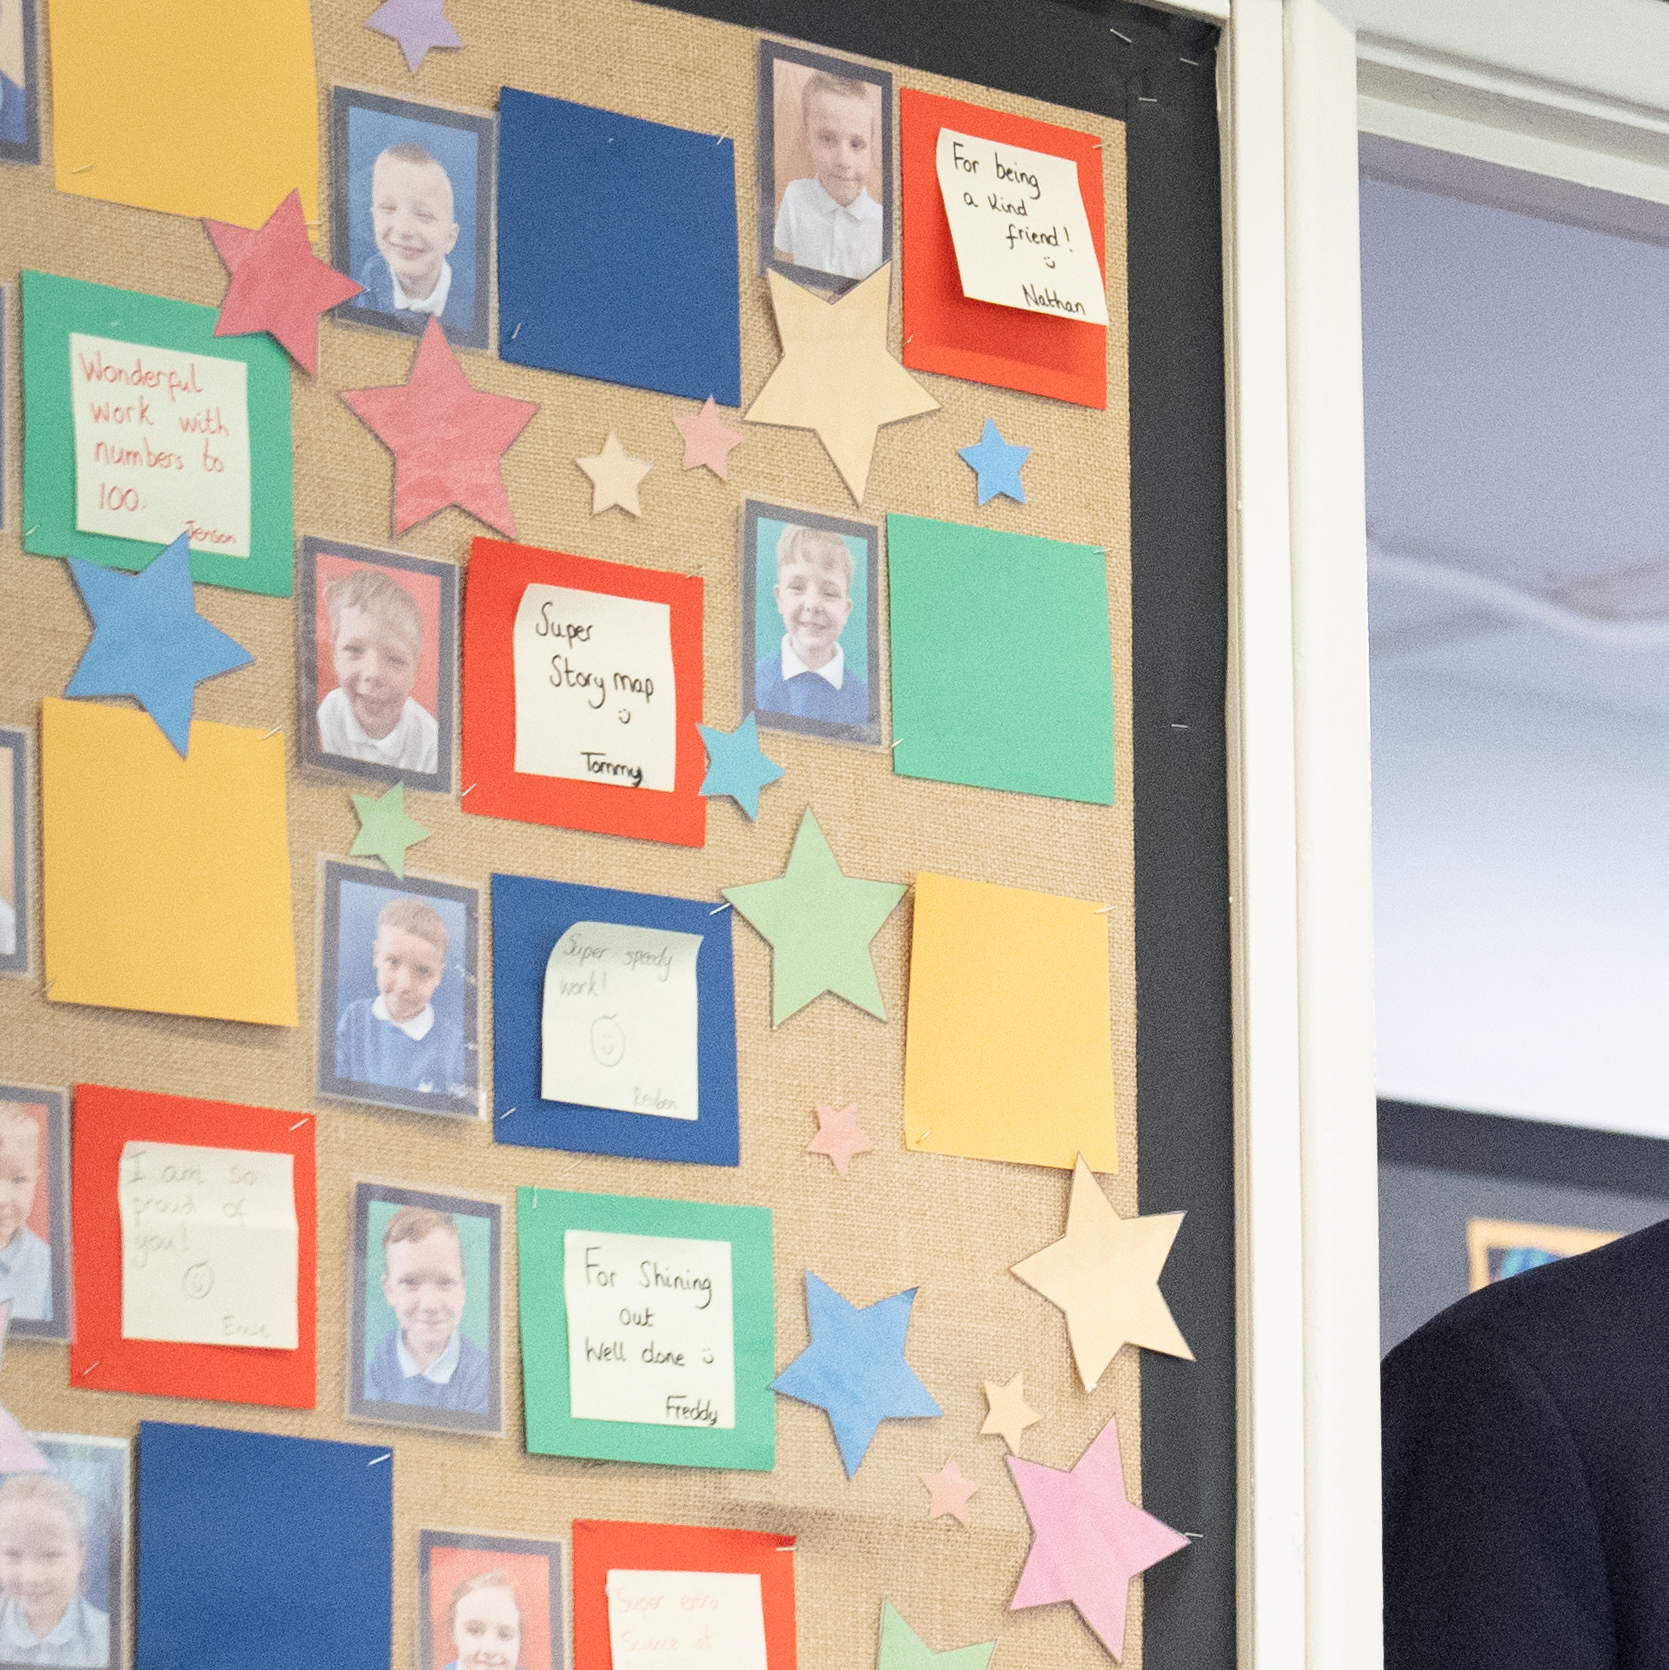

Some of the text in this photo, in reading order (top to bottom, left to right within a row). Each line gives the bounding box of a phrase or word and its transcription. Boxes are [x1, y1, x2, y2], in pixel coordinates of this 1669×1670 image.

[953, 141, 1041, 200] For being
[963, 192, 978, 207] a
[1021, 283, 1086, 316] Nathan
[80, 350, 204, 402] Wonderful
[179, 407, 230, 436] with
[94, 436, 225, 472] numbers to
[185, 519, 237, 544] Jenson
[535, 601, 594, 648] Super
[550, 654, 654, 709] Story map
[580, 751, 644, 788] Tommy
[563, 932, 673, 982] Super speedy
[124, 1152, 146, 1183] I
[162, 1165, 205, 1184] am
[134, 1192, 246, 1228] proud of
[585, 1247, 617, 1288] For
[585, 1336, 686, 1367] Well done
[665, 1394, 719, 1426] Freddy
[614, 1585, 665, 1617] Super
